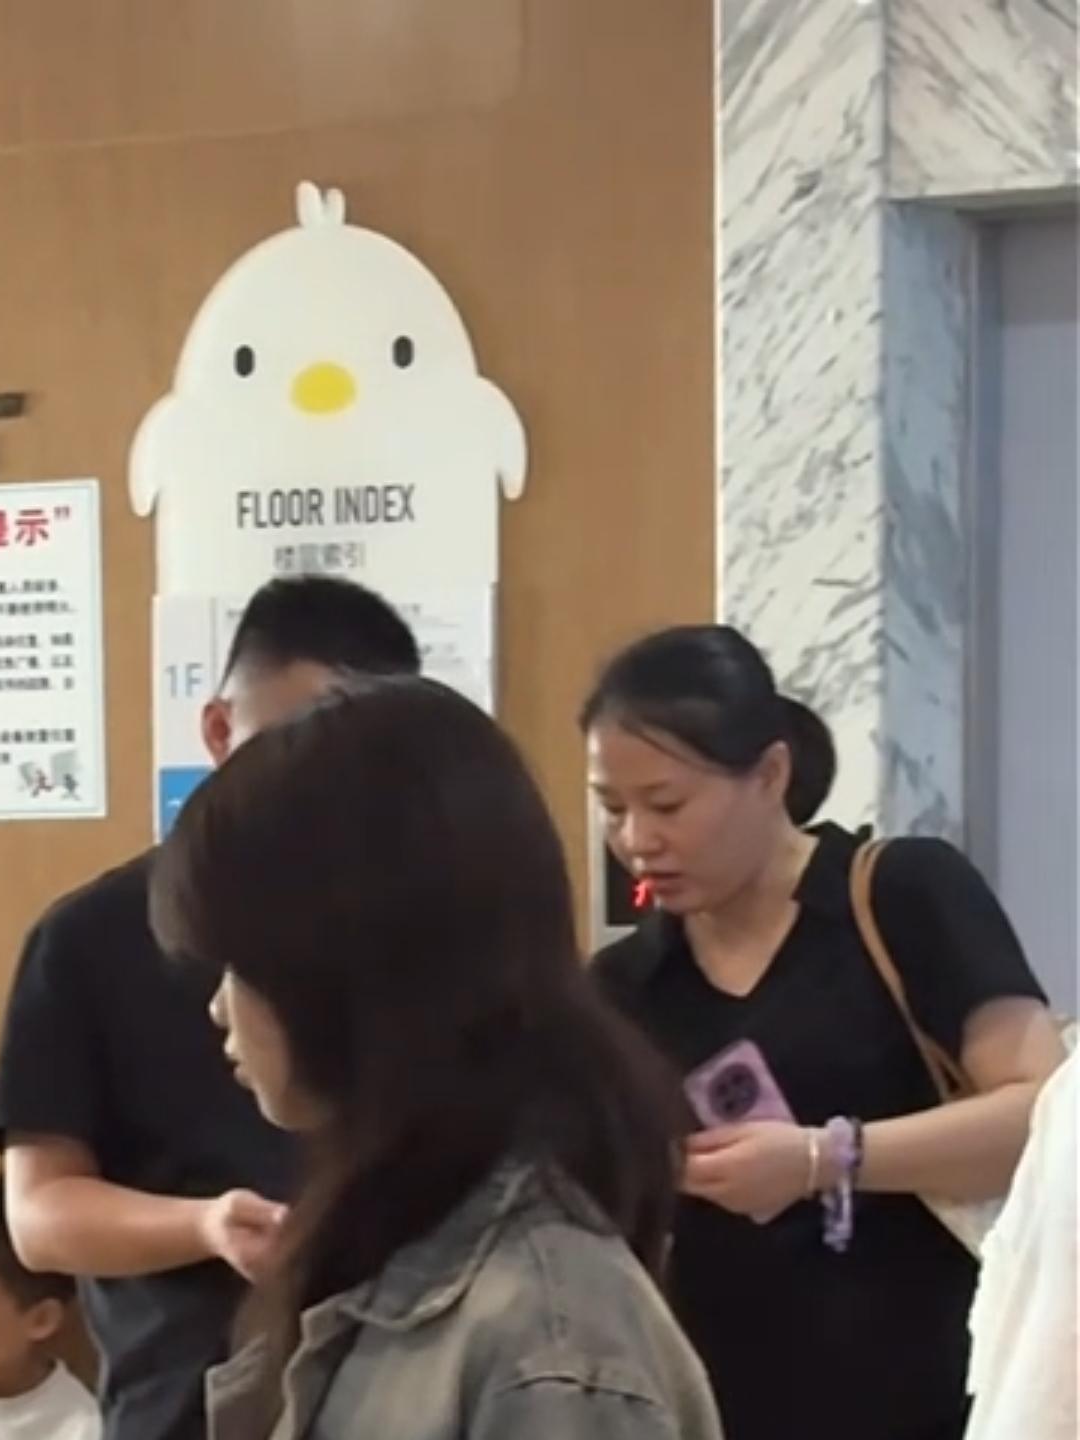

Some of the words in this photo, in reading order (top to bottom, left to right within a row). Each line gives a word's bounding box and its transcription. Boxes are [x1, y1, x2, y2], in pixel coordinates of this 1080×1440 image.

[236, 487, 325, 529] FLOOR
[334, 483, 416, 525] INDEX
[164, 662, 204, 699] 1F
